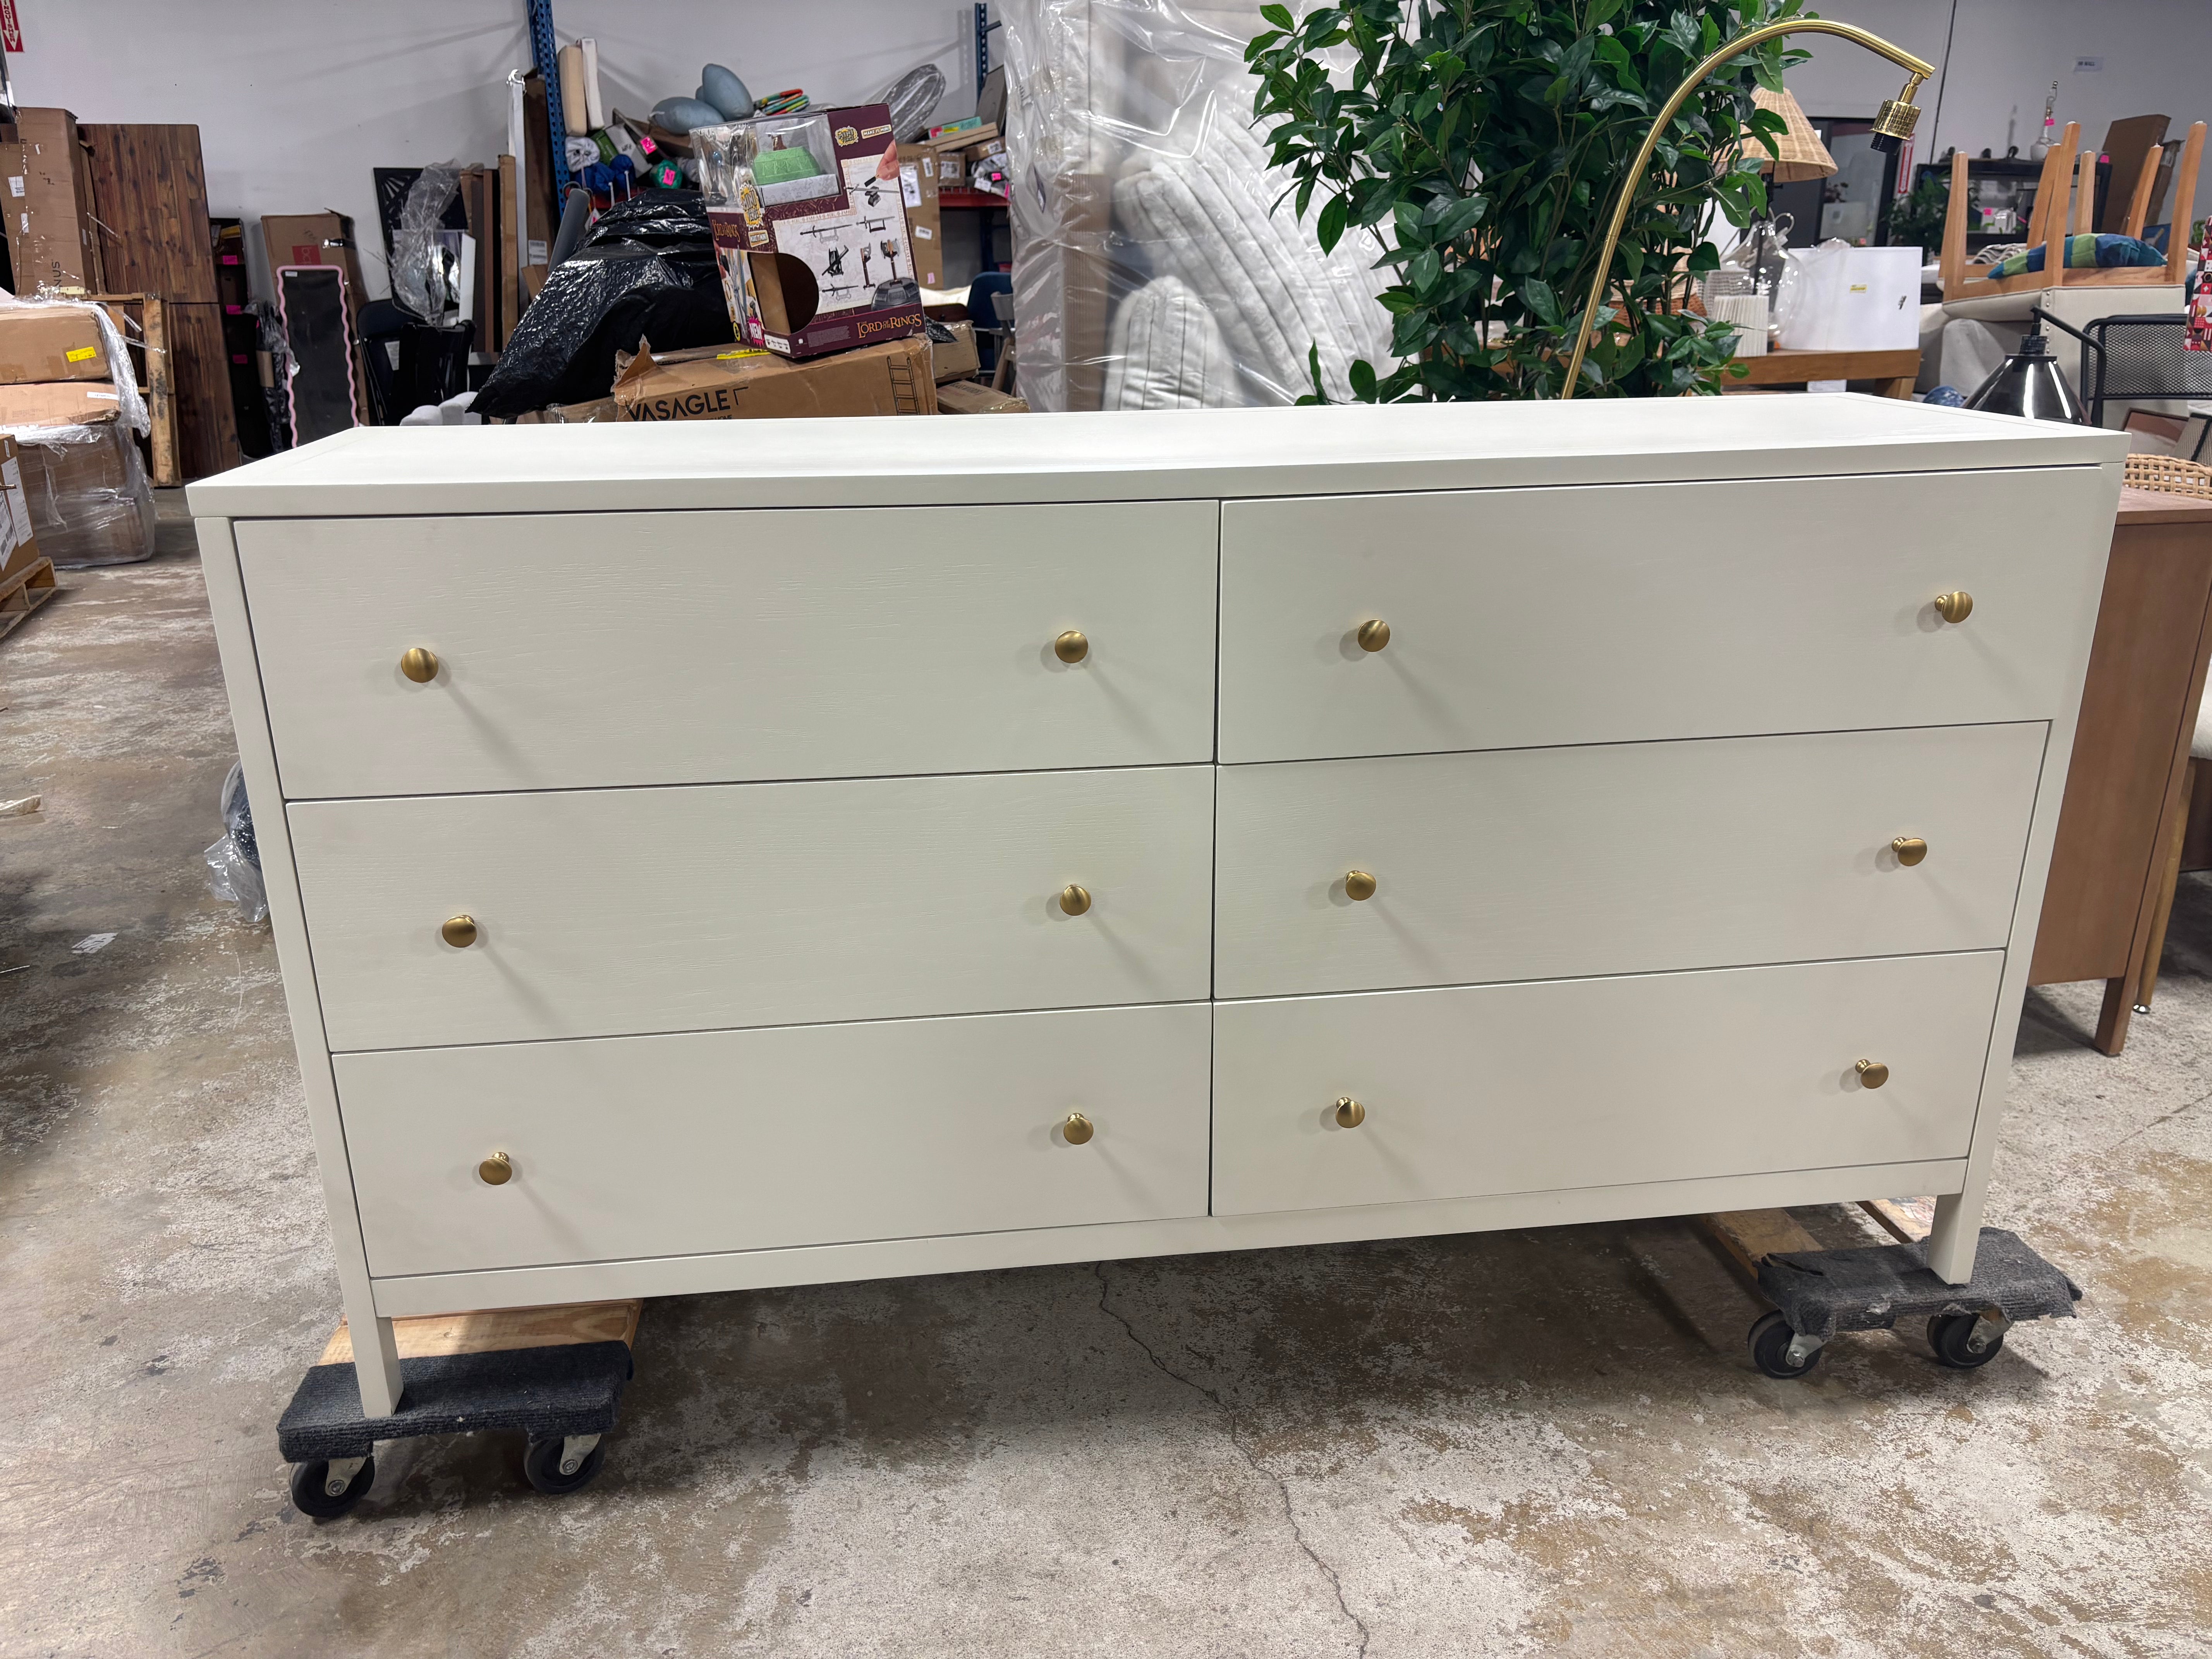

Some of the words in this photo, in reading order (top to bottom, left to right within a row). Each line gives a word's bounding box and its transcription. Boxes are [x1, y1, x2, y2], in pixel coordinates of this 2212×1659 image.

[857, 321, 883, 338] LORD
[889, 314, 922, 329] RINGS
[624, 389, 730, 421] VASAGLE
